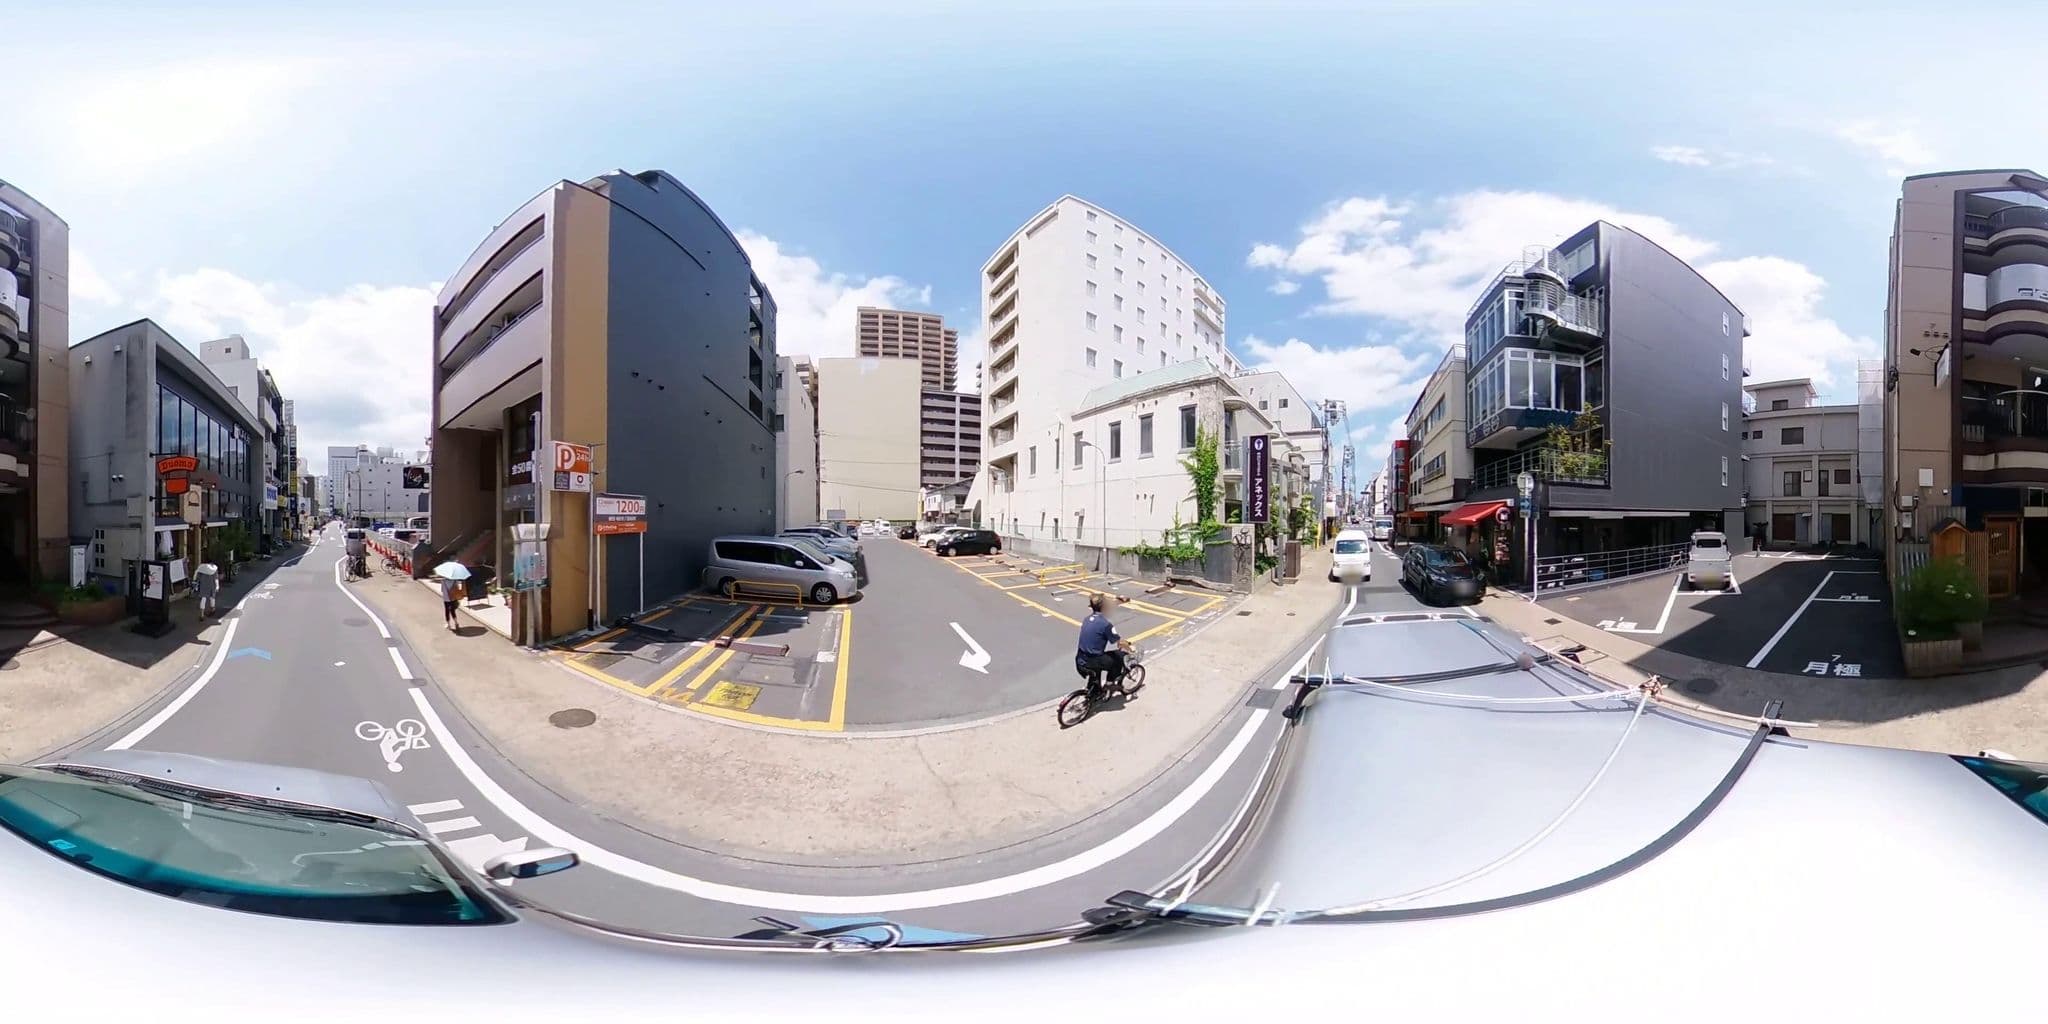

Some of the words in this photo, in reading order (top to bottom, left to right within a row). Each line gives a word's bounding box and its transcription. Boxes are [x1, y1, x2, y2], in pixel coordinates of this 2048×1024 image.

[1254, 477, 1264, 518] アネックス
[1831, 654, 1842, 662] 7
[1802, 661, 1861, 677] 月極
